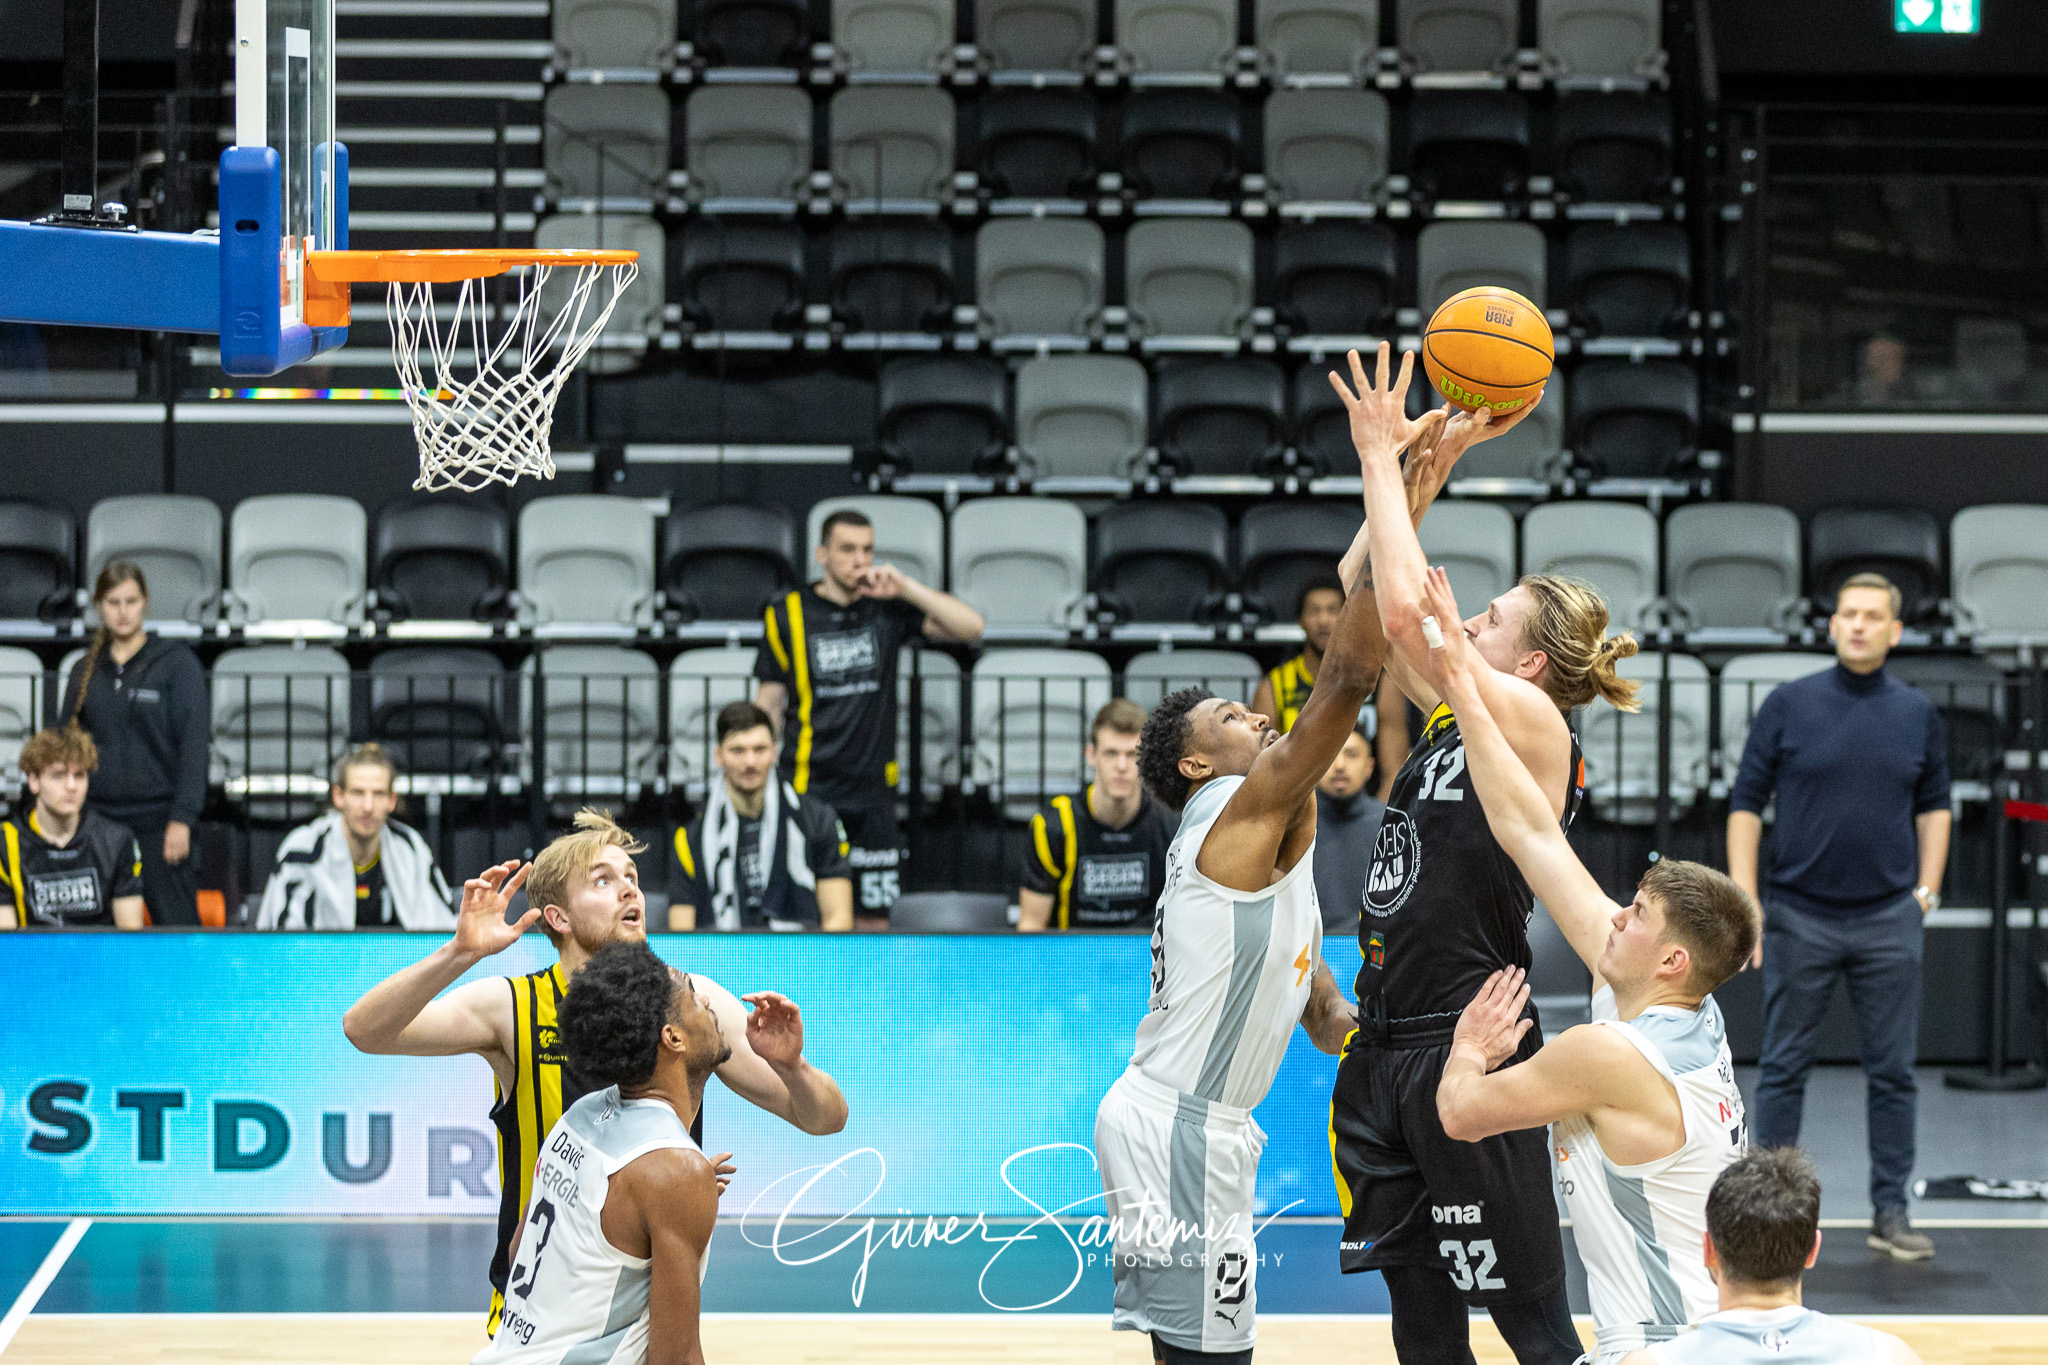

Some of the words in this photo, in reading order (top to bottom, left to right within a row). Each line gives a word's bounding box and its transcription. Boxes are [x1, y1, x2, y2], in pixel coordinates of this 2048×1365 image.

[1485, 310, 1514, 327] FIBA
[1417, 744, 1466, 801] 32
[860, 870, 901, 910] 55
[1367, 854, 1404, 893] BAU
[551, 1131, 585, 1171] Davis
[512, 1196, 556, 1301] 3
[1439, 1238, 1507, 1291] 32
[1214, 1252, 1248, 1305] 9
